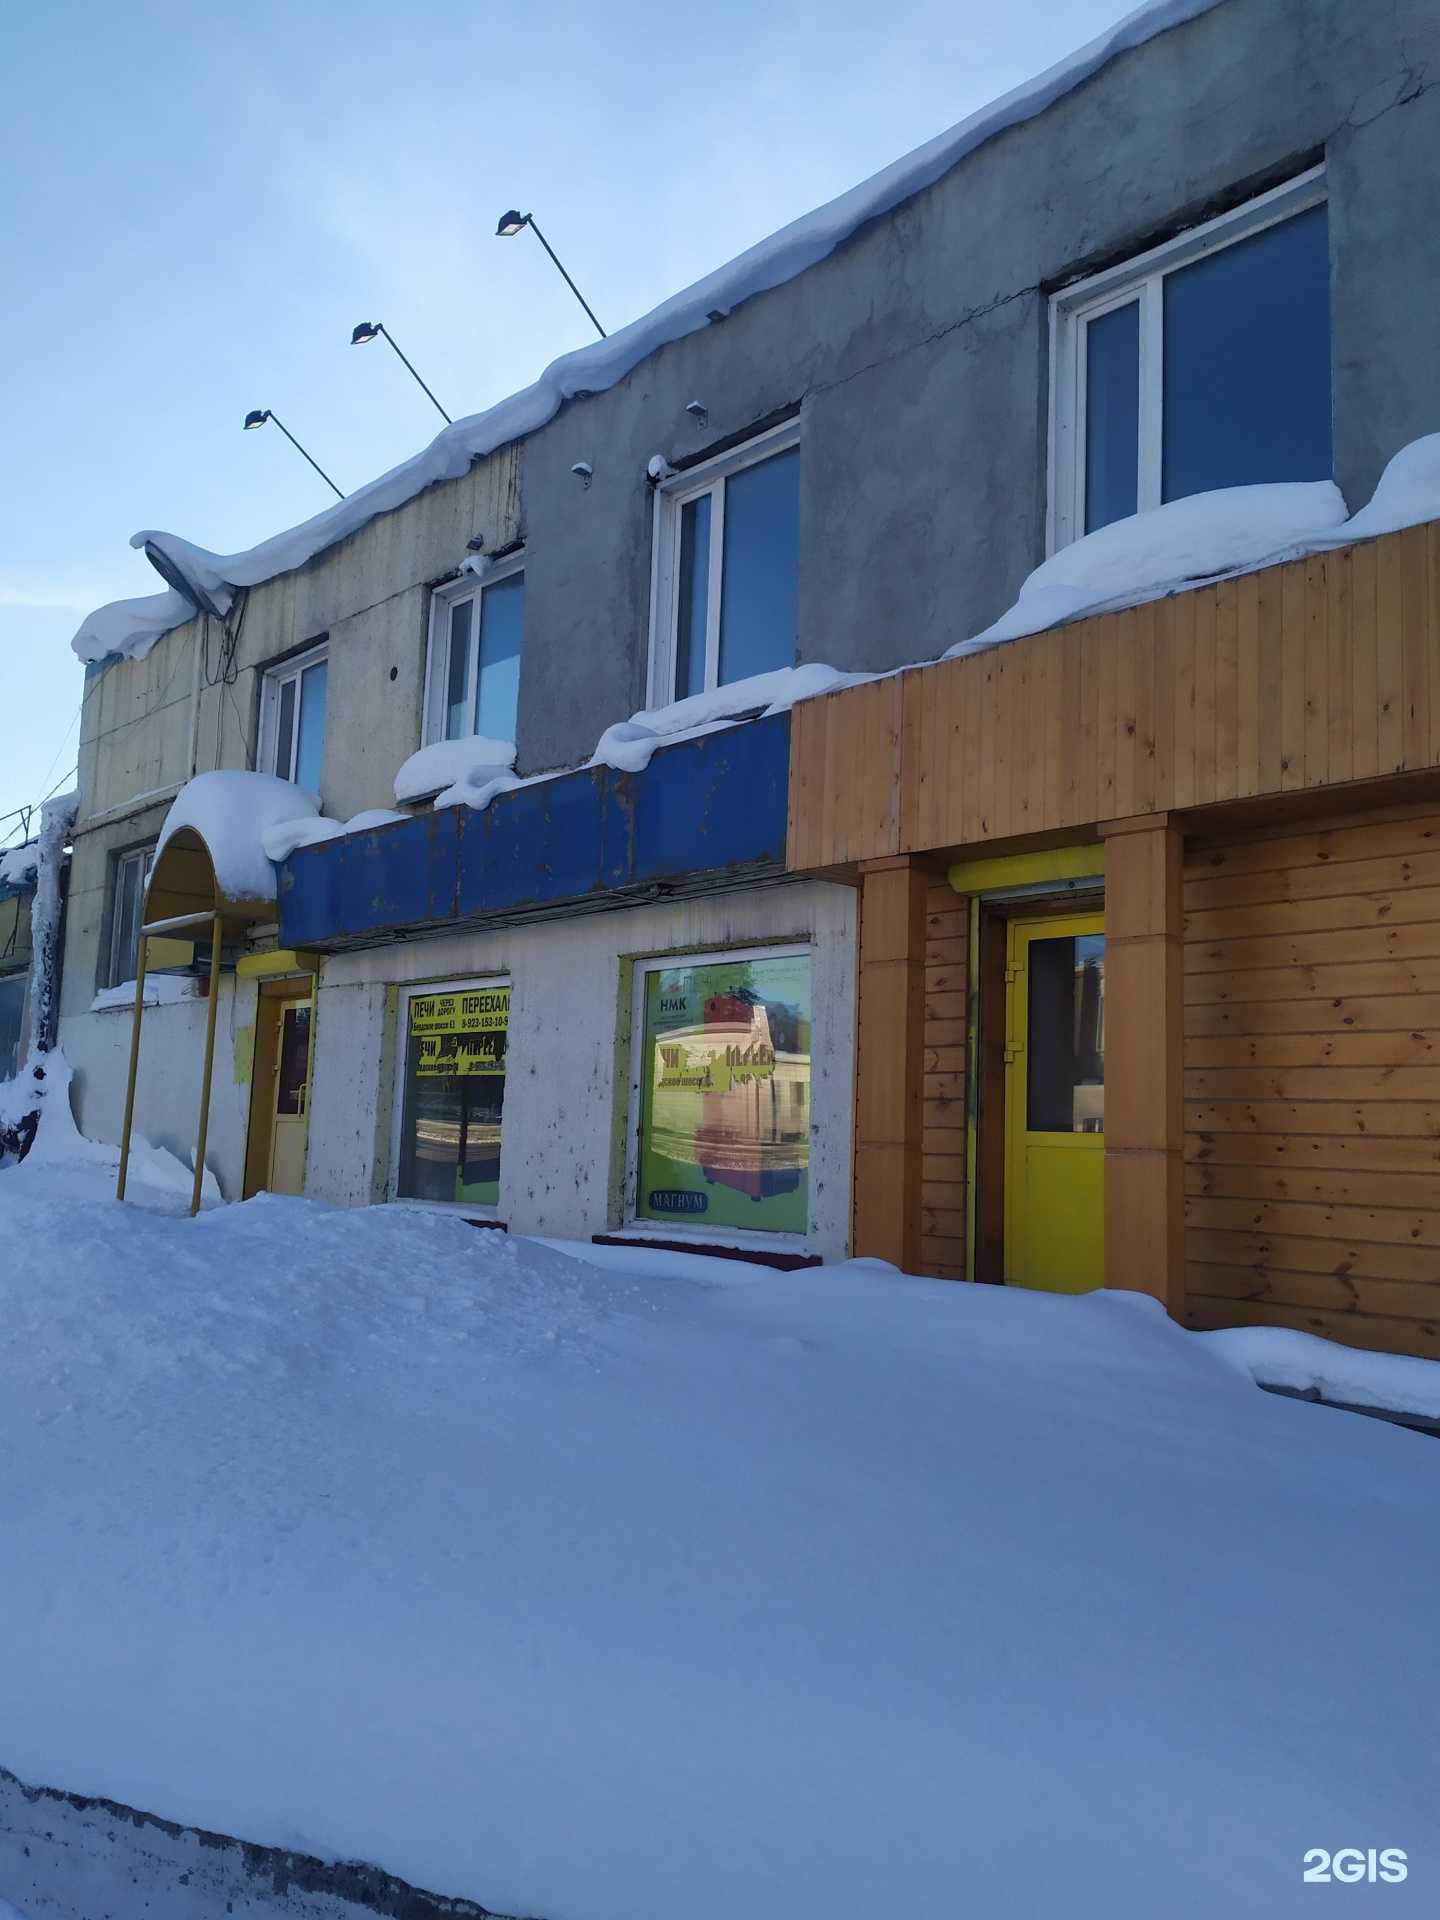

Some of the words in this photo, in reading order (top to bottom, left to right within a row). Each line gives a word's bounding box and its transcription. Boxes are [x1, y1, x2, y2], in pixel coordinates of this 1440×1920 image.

[414, 1001, 435, 1018] ПЕЧИ
[660, 998, 687, 1012] НМК
[653, 1192, 704, 1209] МАГНУМ
